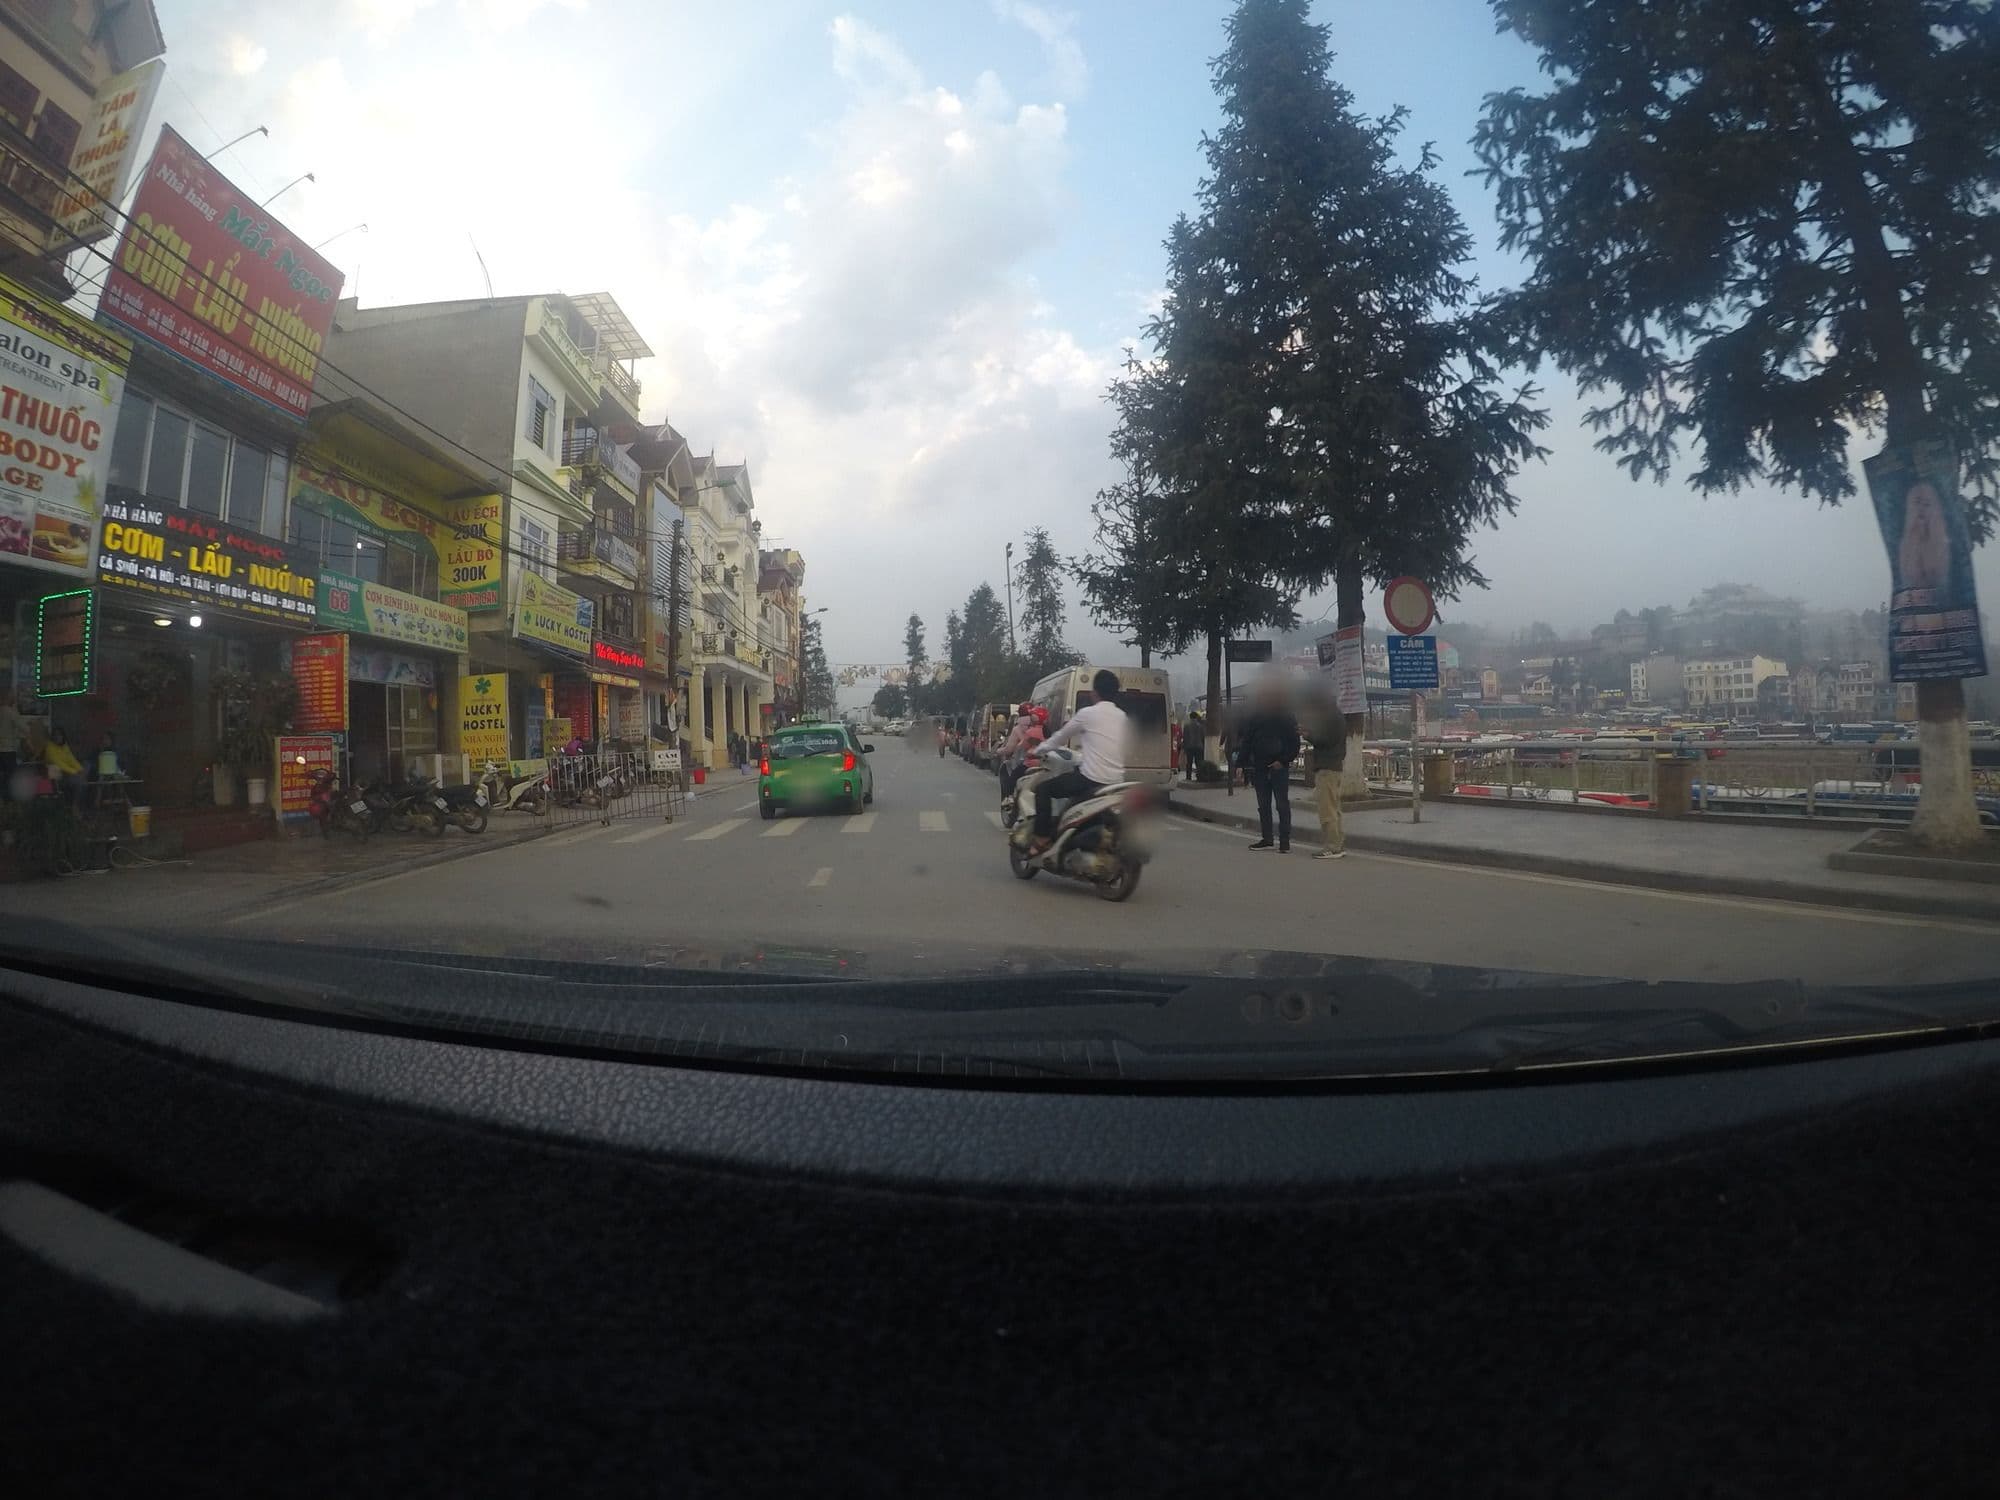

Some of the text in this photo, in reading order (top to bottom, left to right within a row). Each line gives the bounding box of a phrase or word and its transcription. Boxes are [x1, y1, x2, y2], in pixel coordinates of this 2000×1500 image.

[123, 211, 322, 383] CƠM LẨU NƯỚNG
[59, 363, 101, 391] spa
[1, 385, 101, 452] THUỐC
[0, 430, 85, 478] BODY
[0, 467, 44, 492] GE
[103, 500, 128, 521] NHÀ
[131, 503, 163, 525] HÀNG
[99, 553, 114, 571] CÁ
[144, 564, 157, 580] CÁ
[180, 572, 192, 588] CÁ
[104, 521, 316, 599] CƠM LẨU NƯỚNG
[453, 565, 487, 583] 300K
[328, 587, 350, 614] 68
[366, 590, 382, 605] CƠM
[535, 613, 562, 634] LUCKY
[564, 624, 590, 644] HOSTEL
[465, 703, 502, 717] LUCKY
[463, 718, 506, 731] HOSTEL
